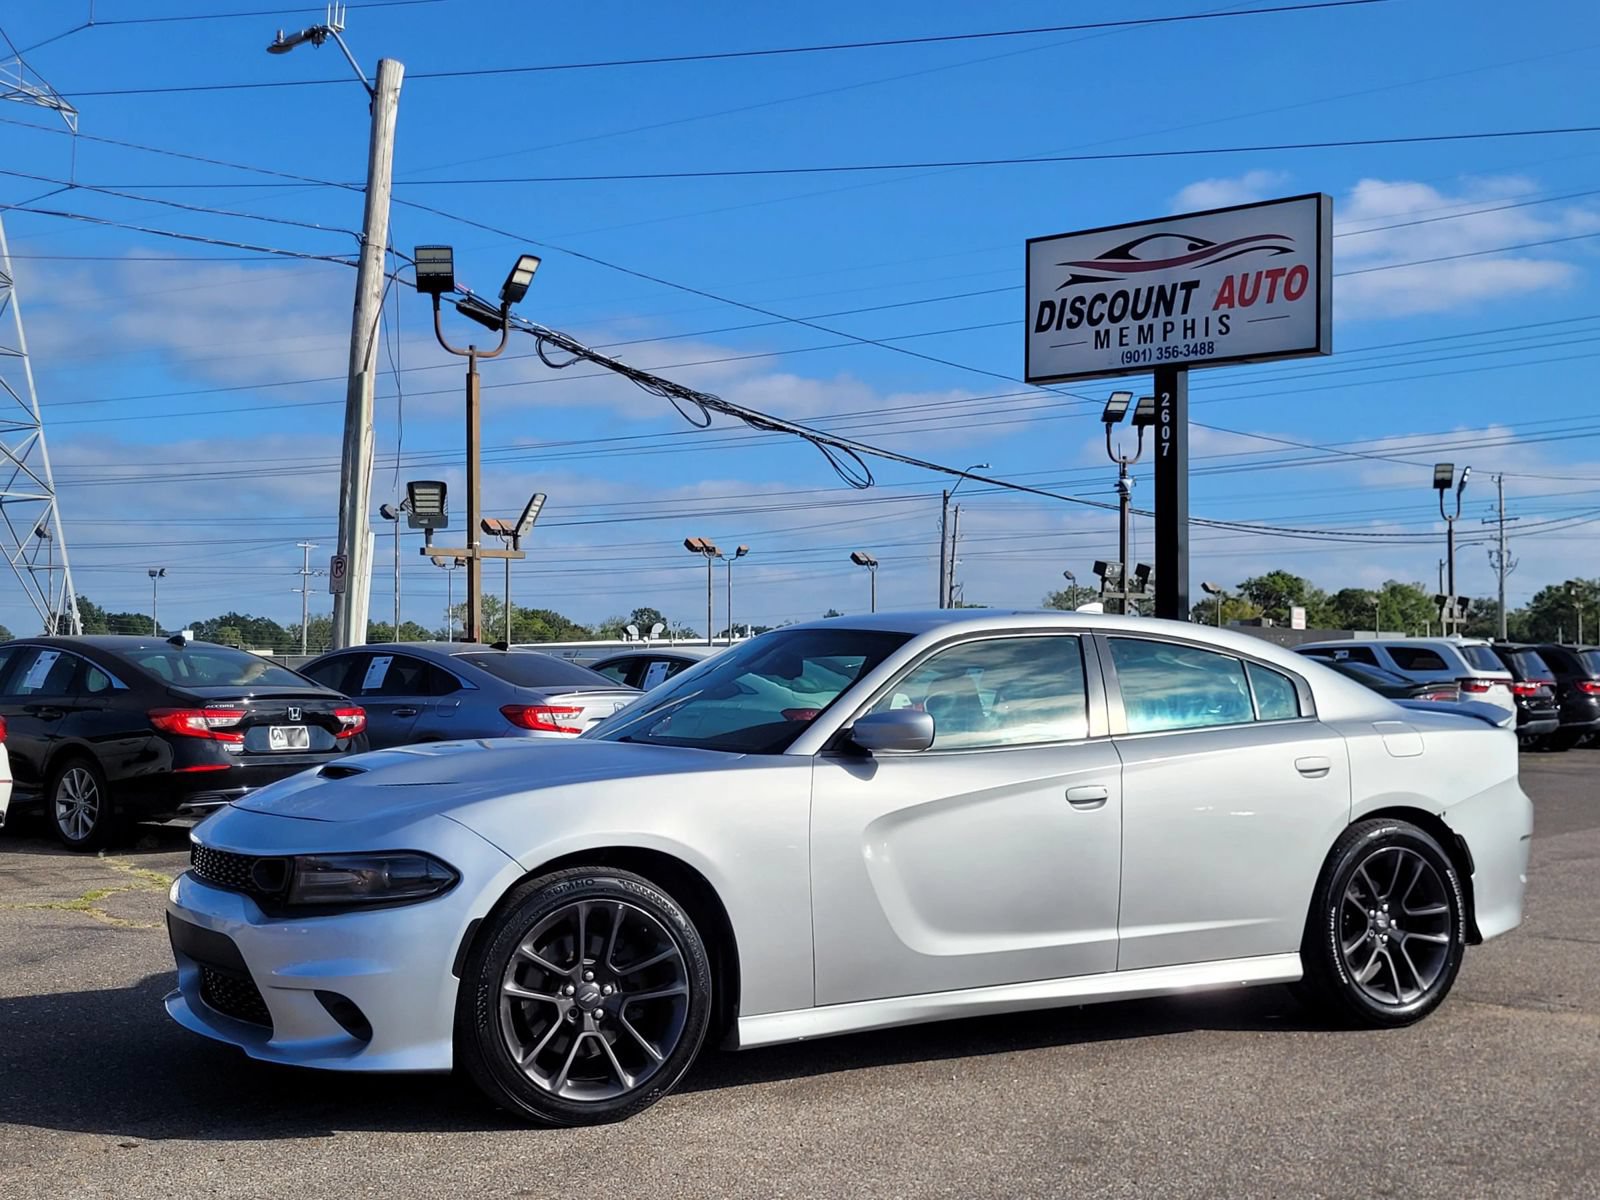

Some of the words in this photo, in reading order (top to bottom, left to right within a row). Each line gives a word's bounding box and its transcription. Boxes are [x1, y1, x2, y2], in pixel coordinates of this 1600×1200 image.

[1034, 279, 1201, 333] DISCOUNT
[1212, 264, 1310, 311] AUTO
[1094, 314, 1231, 350] MEMPHIS
[1120, 348, 1152, 366] (901)
[1156, 341, 1215, 360] 356-3488
[1160, 391, 1171, 457] 2607
